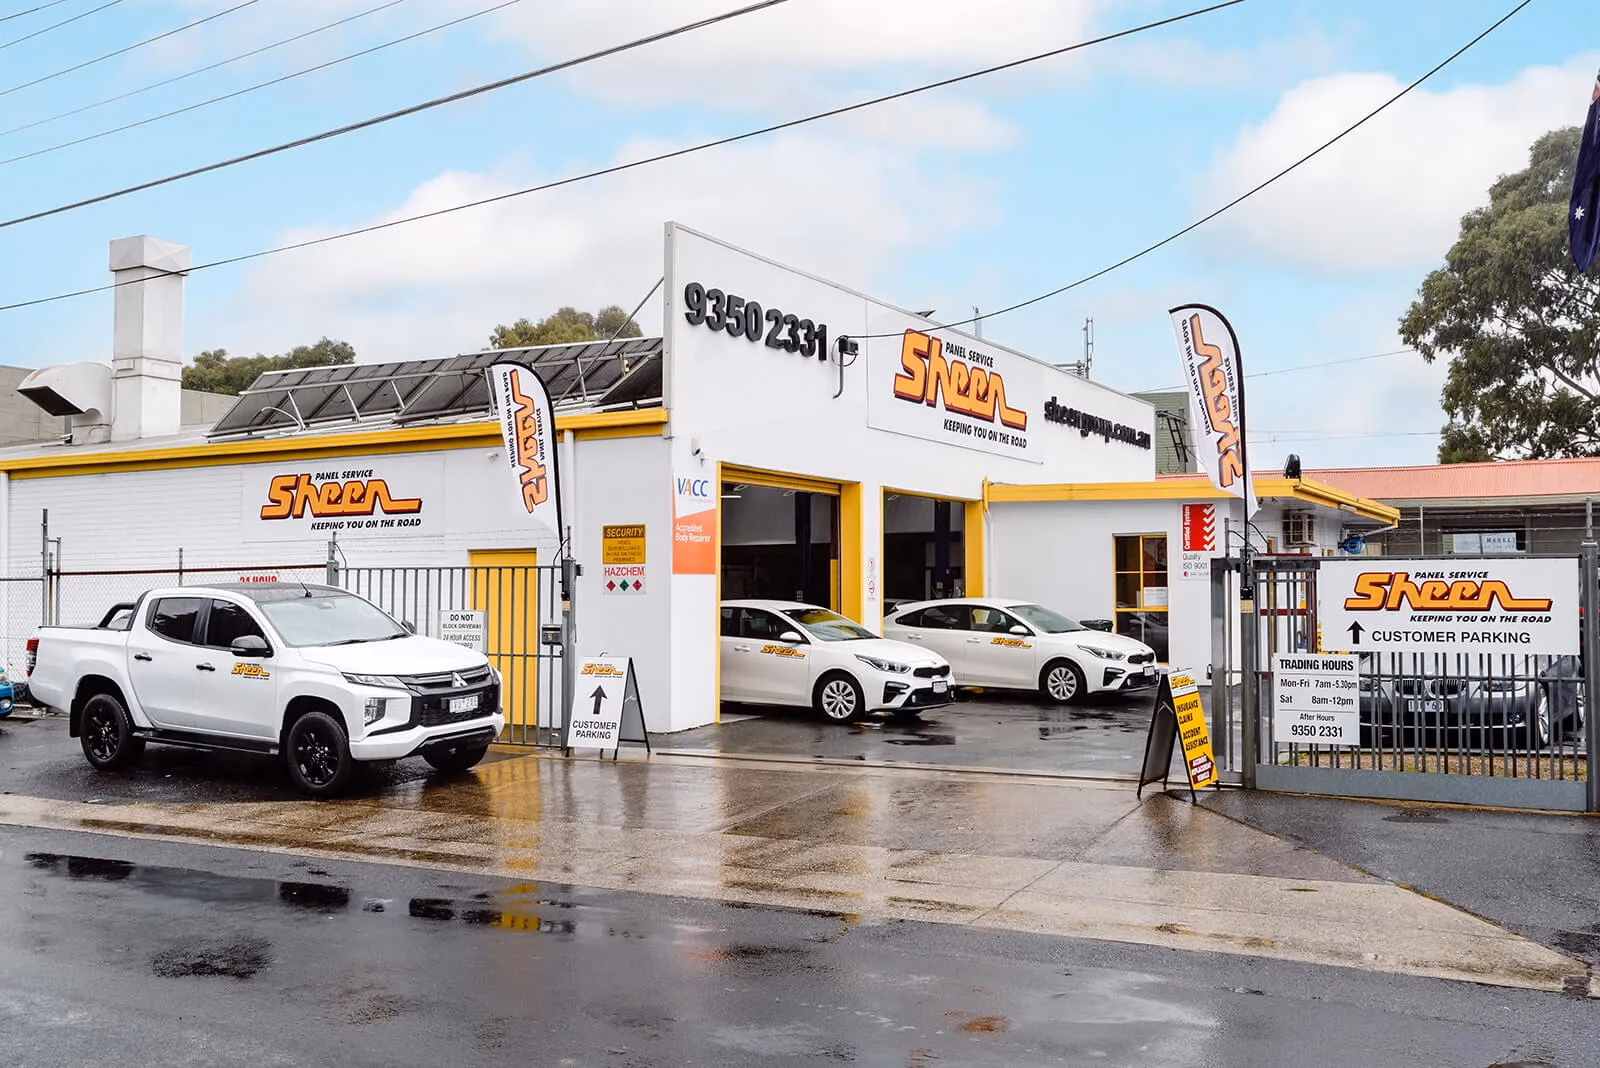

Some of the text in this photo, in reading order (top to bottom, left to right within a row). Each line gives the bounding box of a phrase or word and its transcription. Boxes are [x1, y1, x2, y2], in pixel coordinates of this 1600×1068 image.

[685, 282, 827, 361] 9350 2331
[945, 342, 994, 368] PANEL SERVICE
[893, 328, 1027, 432] Sheen
[943, 418, 1027, 448] KEEPING YOU ON THE ROAD
[315, 469, 373, 480] PANEL SERVICE
[677, 477, 709, 497] VACC
[260, 473, 422, 520] Sheen
[311, 518, 421, 530] KEEPING YOU ON THE ROAD
[676, 523, 702, 533] Accredited
[606, 528, 643, 537] SECURITY
[676, 533, 711, 543] Body Repairer
[1183, 553, 1201, 561] Quality
[604, 567, 645, 577] HAZCHEM
[1414, 571, 1490, 579] PANEL SERVICE
[1344, 571, 1553, 612] Sheen
[1410, 615, 1452, 623] KEEPING
[1455, 615, 1478, 623] YOU
[1480, 615, 1497, 623] ON
[1372, 630, 1531, 644] CUSTOMER PARKING
[761, 644, 805, 657] Sheen
[231, 662, 270, 677] Sheen
[581, 663, 624, 675] Sheen
[1280, 659, 1354, 671] TRADING HOURS
[1280, 679, 1310, 687] Mon-Fri
[1280, 694, 1293, 703] Sat
[1176, 699, 1199, 713] INSURANCE
[1299, 713, 1335, 721] After Hours
[572, 720, 617, 730] CUSTOMER
[1291, 724, 1343, 737] 9350 2331
[575, 730, 611, 739] PARKING
[1183, 726, 1201, 740] ACCIDENT
[1185, 736, 1209, 751] ASSISTANCE
